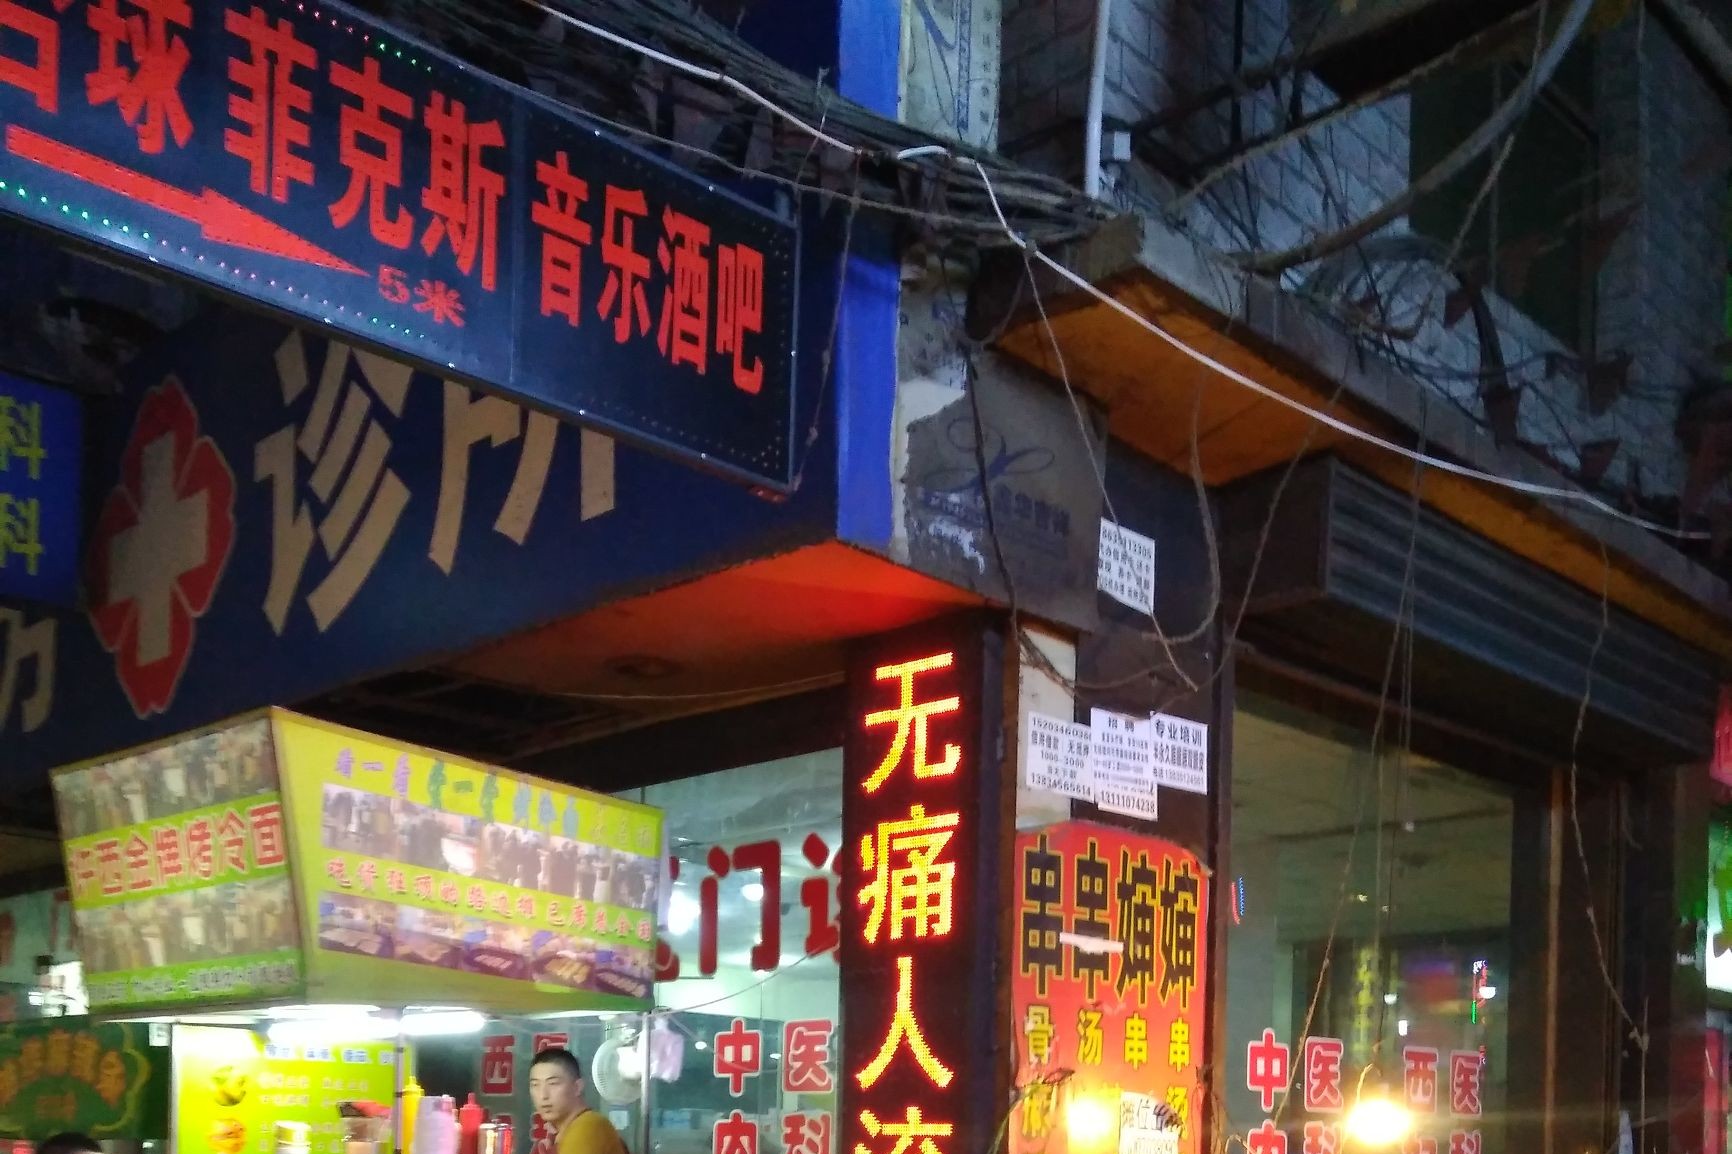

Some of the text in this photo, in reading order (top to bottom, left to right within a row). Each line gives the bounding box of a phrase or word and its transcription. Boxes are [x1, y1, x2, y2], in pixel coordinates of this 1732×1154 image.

[224, 5, 507, 292] 菲克斯
[531, 151, 765, 395] 音乐酒吧
[377, 265, 466, 328] 5米
[1155, 718, 1203, 746] 专业培训
[713, 1017, 835, 1097] 中医
[1023, 1004, 1191, 1073] 骨汤串串
[1246, 1027, 1345, 1114] 中医
[1401, 1045, 1484, 1119] 西医
